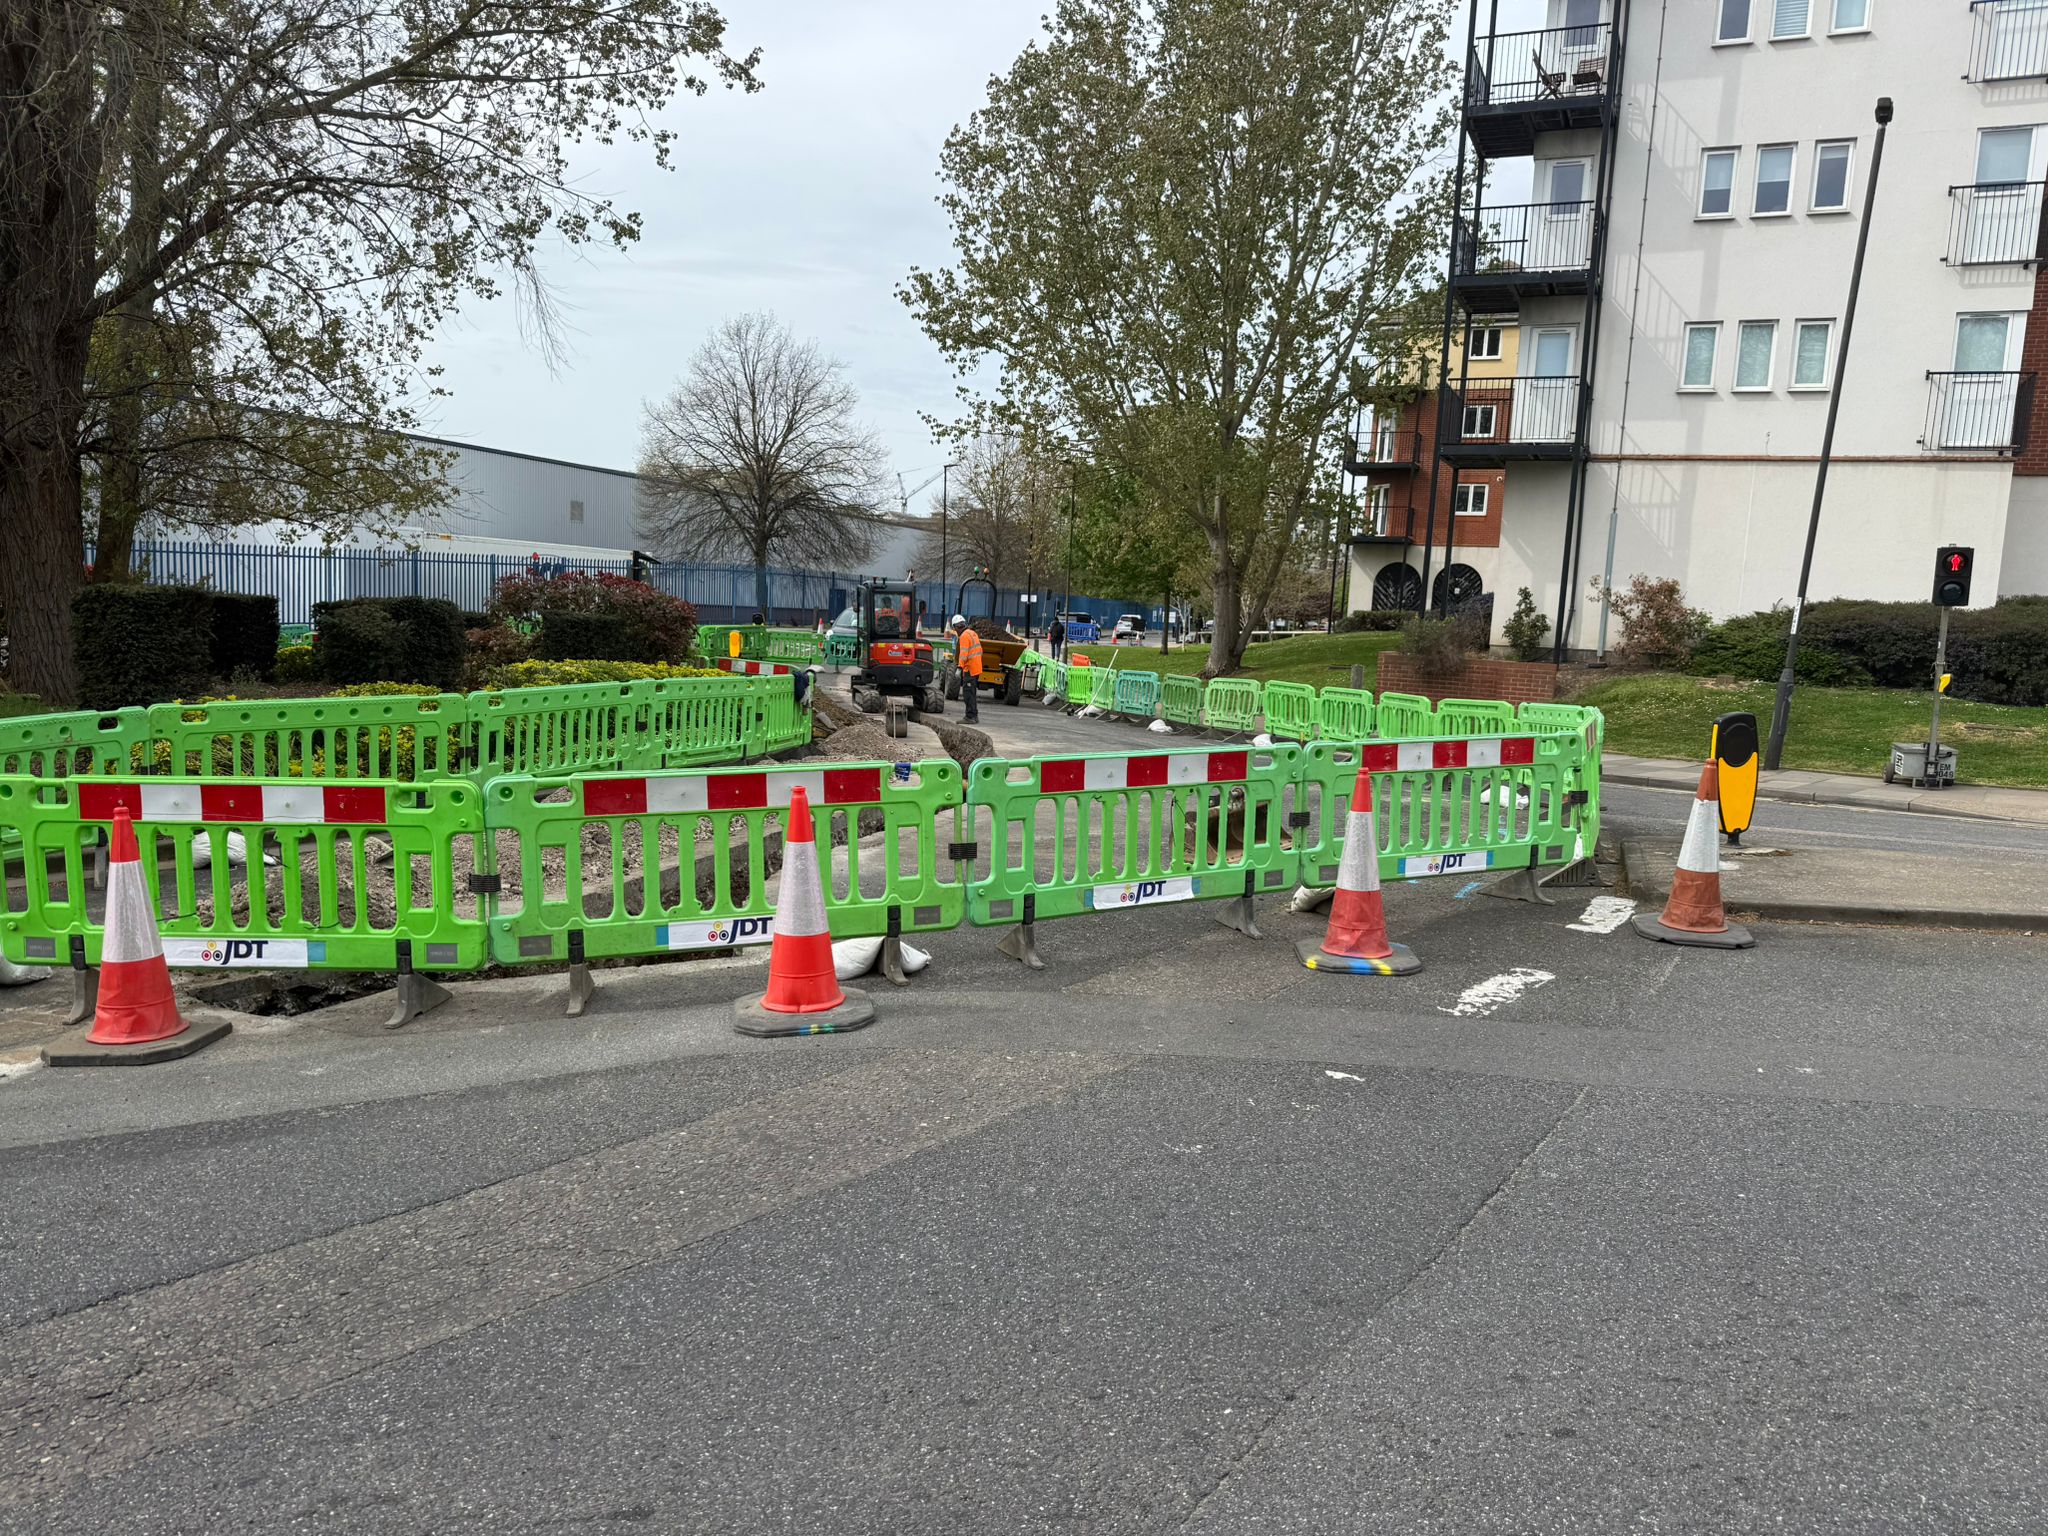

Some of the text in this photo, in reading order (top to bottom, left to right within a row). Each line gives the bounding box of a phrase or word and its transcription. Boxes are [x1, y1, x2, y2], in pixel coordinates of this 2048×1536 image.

[1439, 853, 1466, 874] JDT
[1134, 880, 1167, 904] JDT
[727, 916, 773, 944] JDT
[220, 940, 269, 965] JDT
